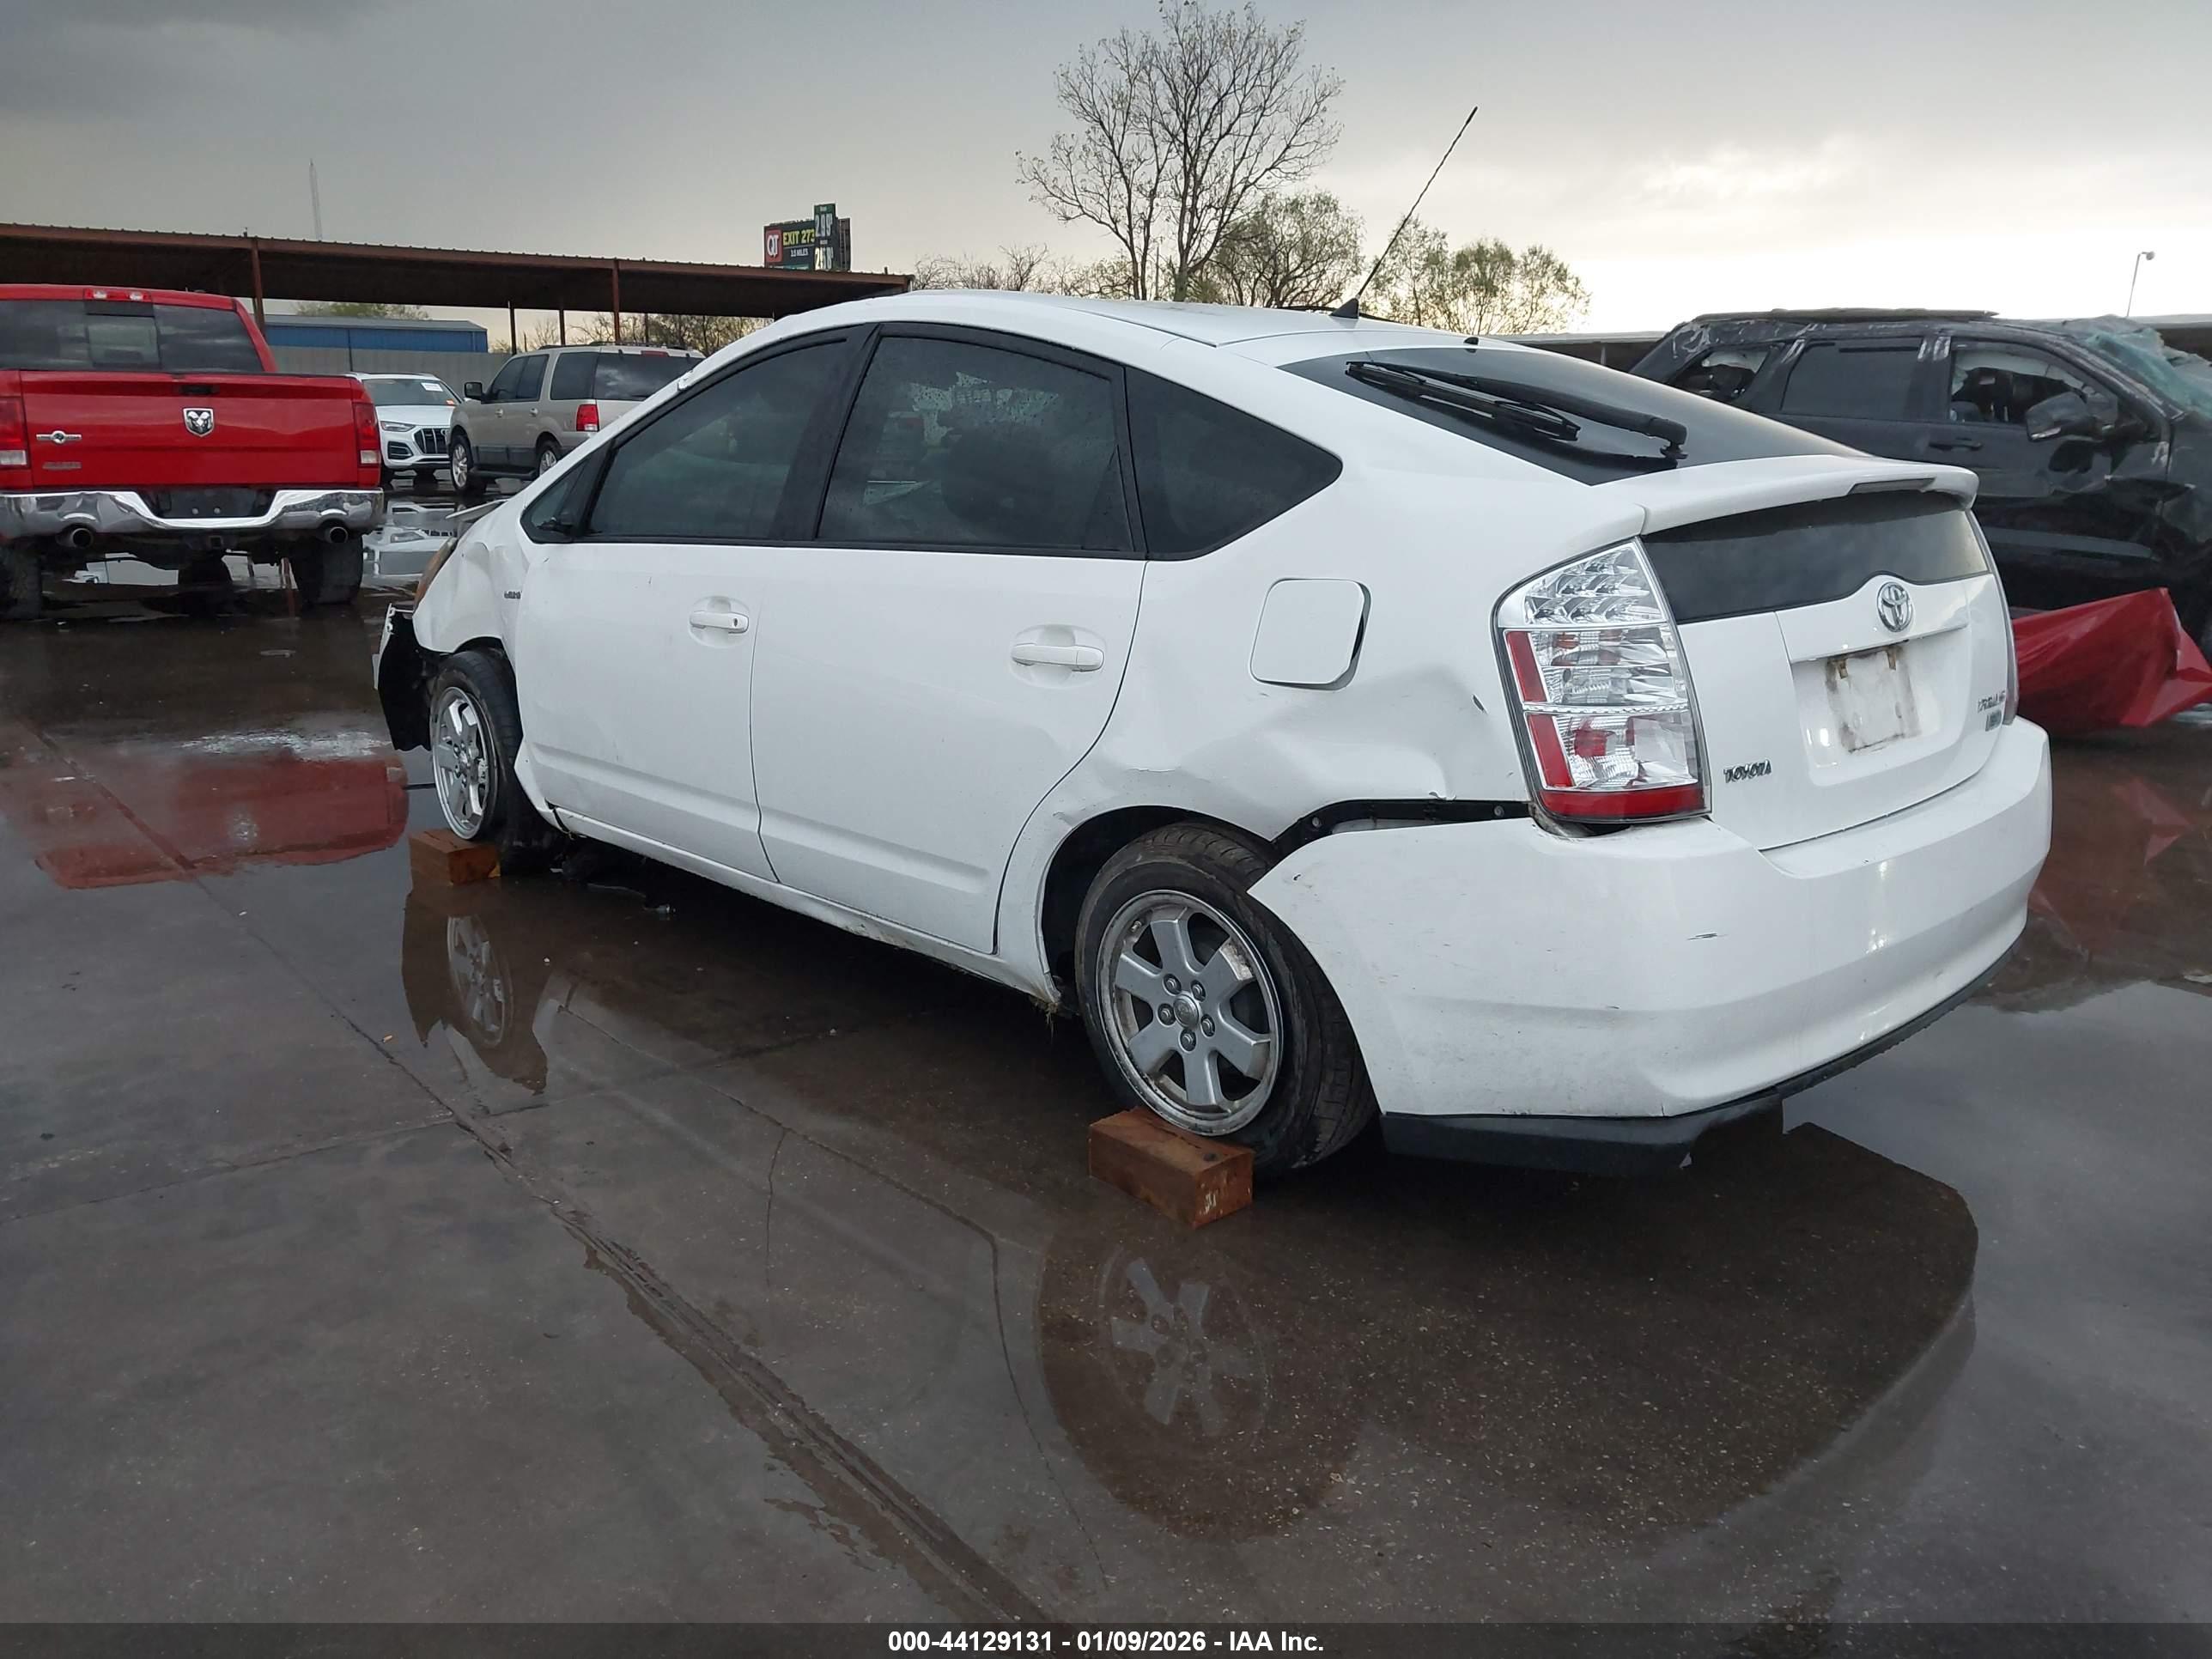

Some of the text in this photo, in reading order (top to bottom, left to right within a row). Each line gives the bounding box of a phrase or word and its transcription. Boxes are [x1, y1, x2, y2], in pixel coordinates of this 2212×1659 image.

[767, 234, 779, 258] QT
[783, 231, 799, 246] EXIT
[1723, 758, 1771, 783] TOYOTA
